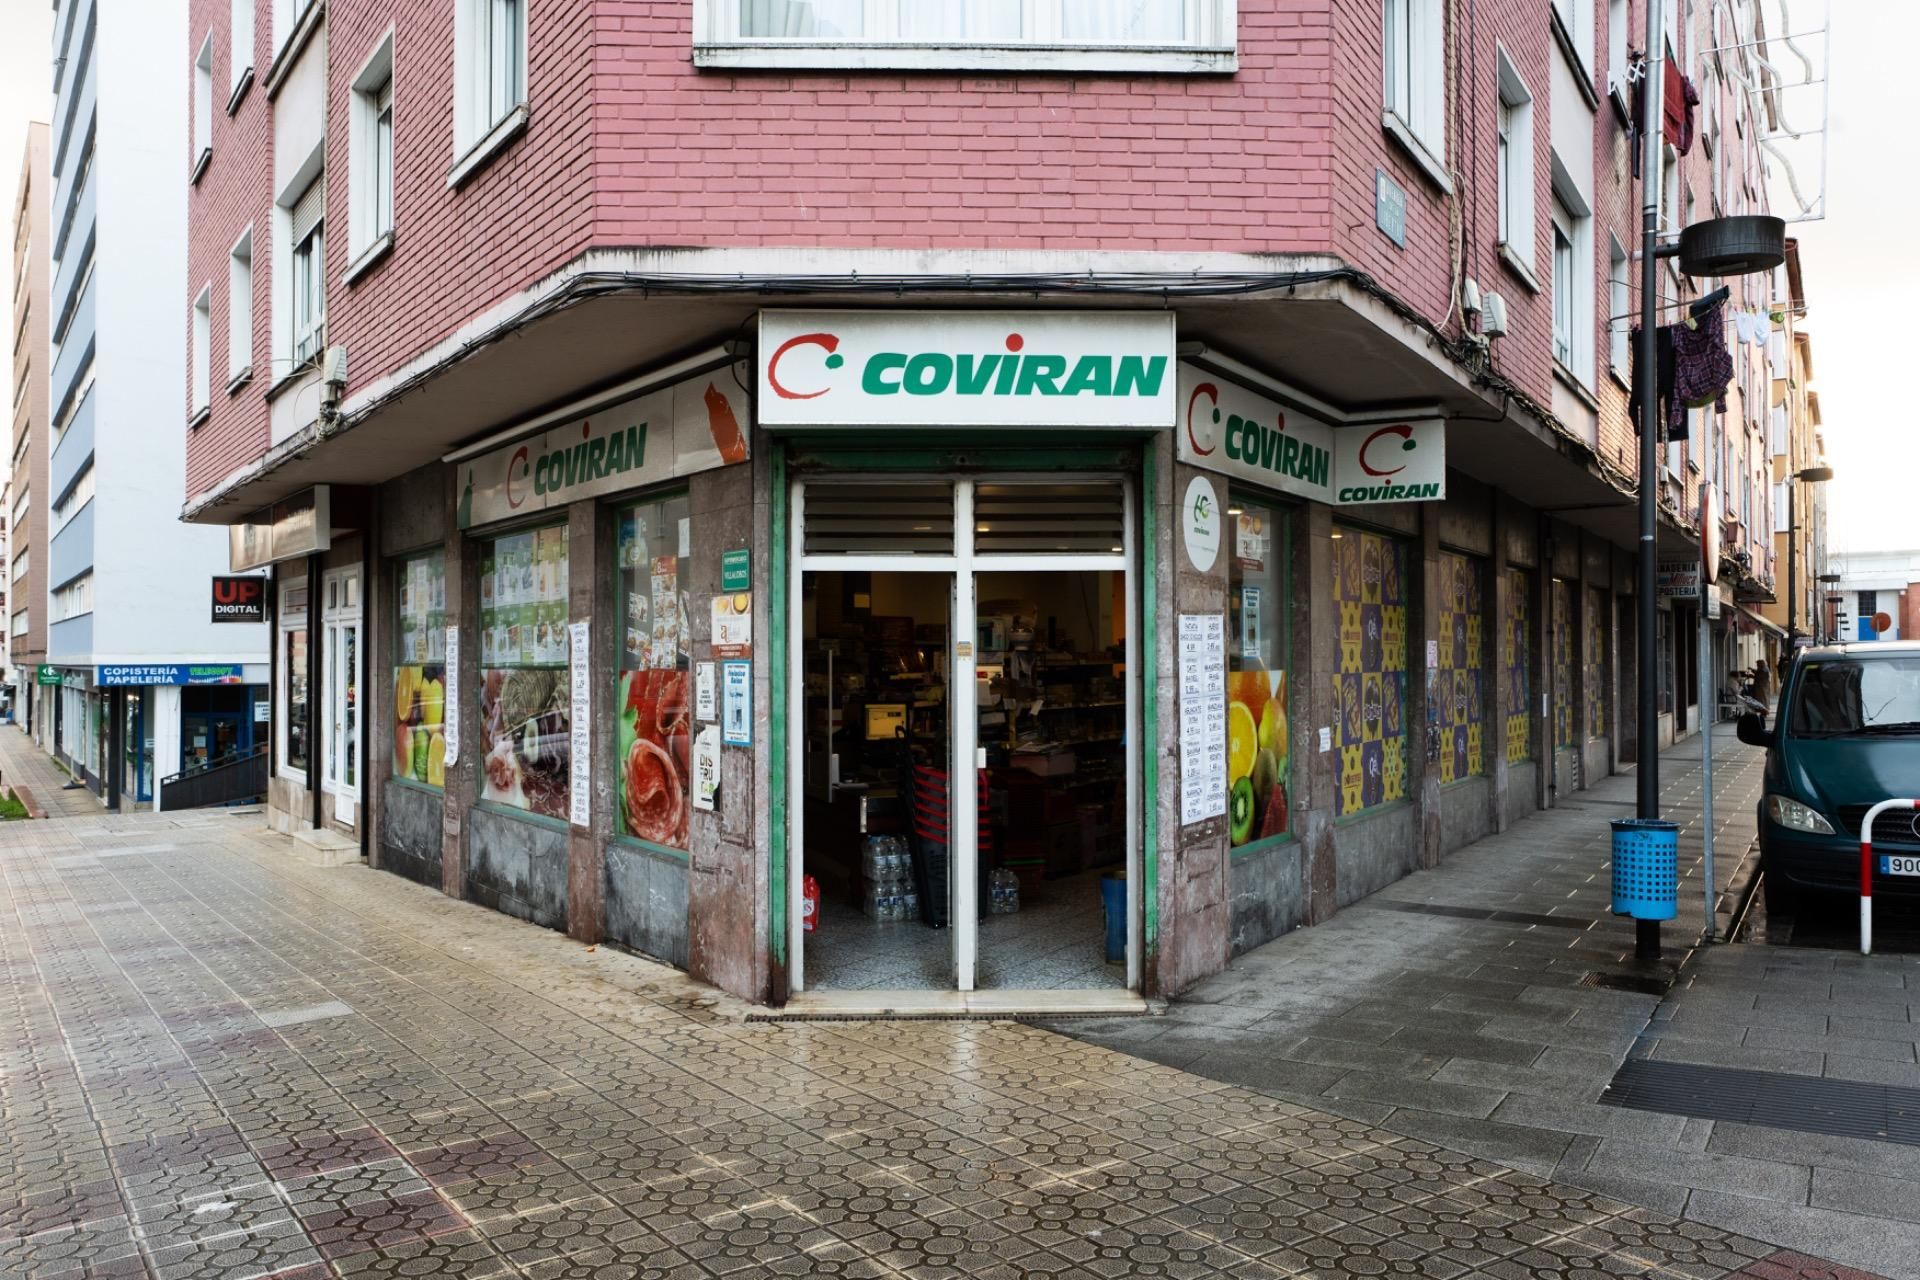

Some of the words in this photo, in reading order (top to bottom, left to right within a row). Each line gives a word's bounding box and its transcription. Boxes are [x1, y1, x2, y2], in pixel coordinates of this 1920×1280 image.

[862, 333, 1168, 397] COVIRAN
[534, 421, 648, 496] COVIRAN
[1225, 412, 1330, 488] COVIRAN
[1338, 479, 1440, 502] COVIRAN
[215, 581, 259, 603] UP
[215, 605, 260, 614] DIGITAL
[103, 666, 178, 675] COPISTERÍA
[106, 675, 174, 684] PAPELERÍA
